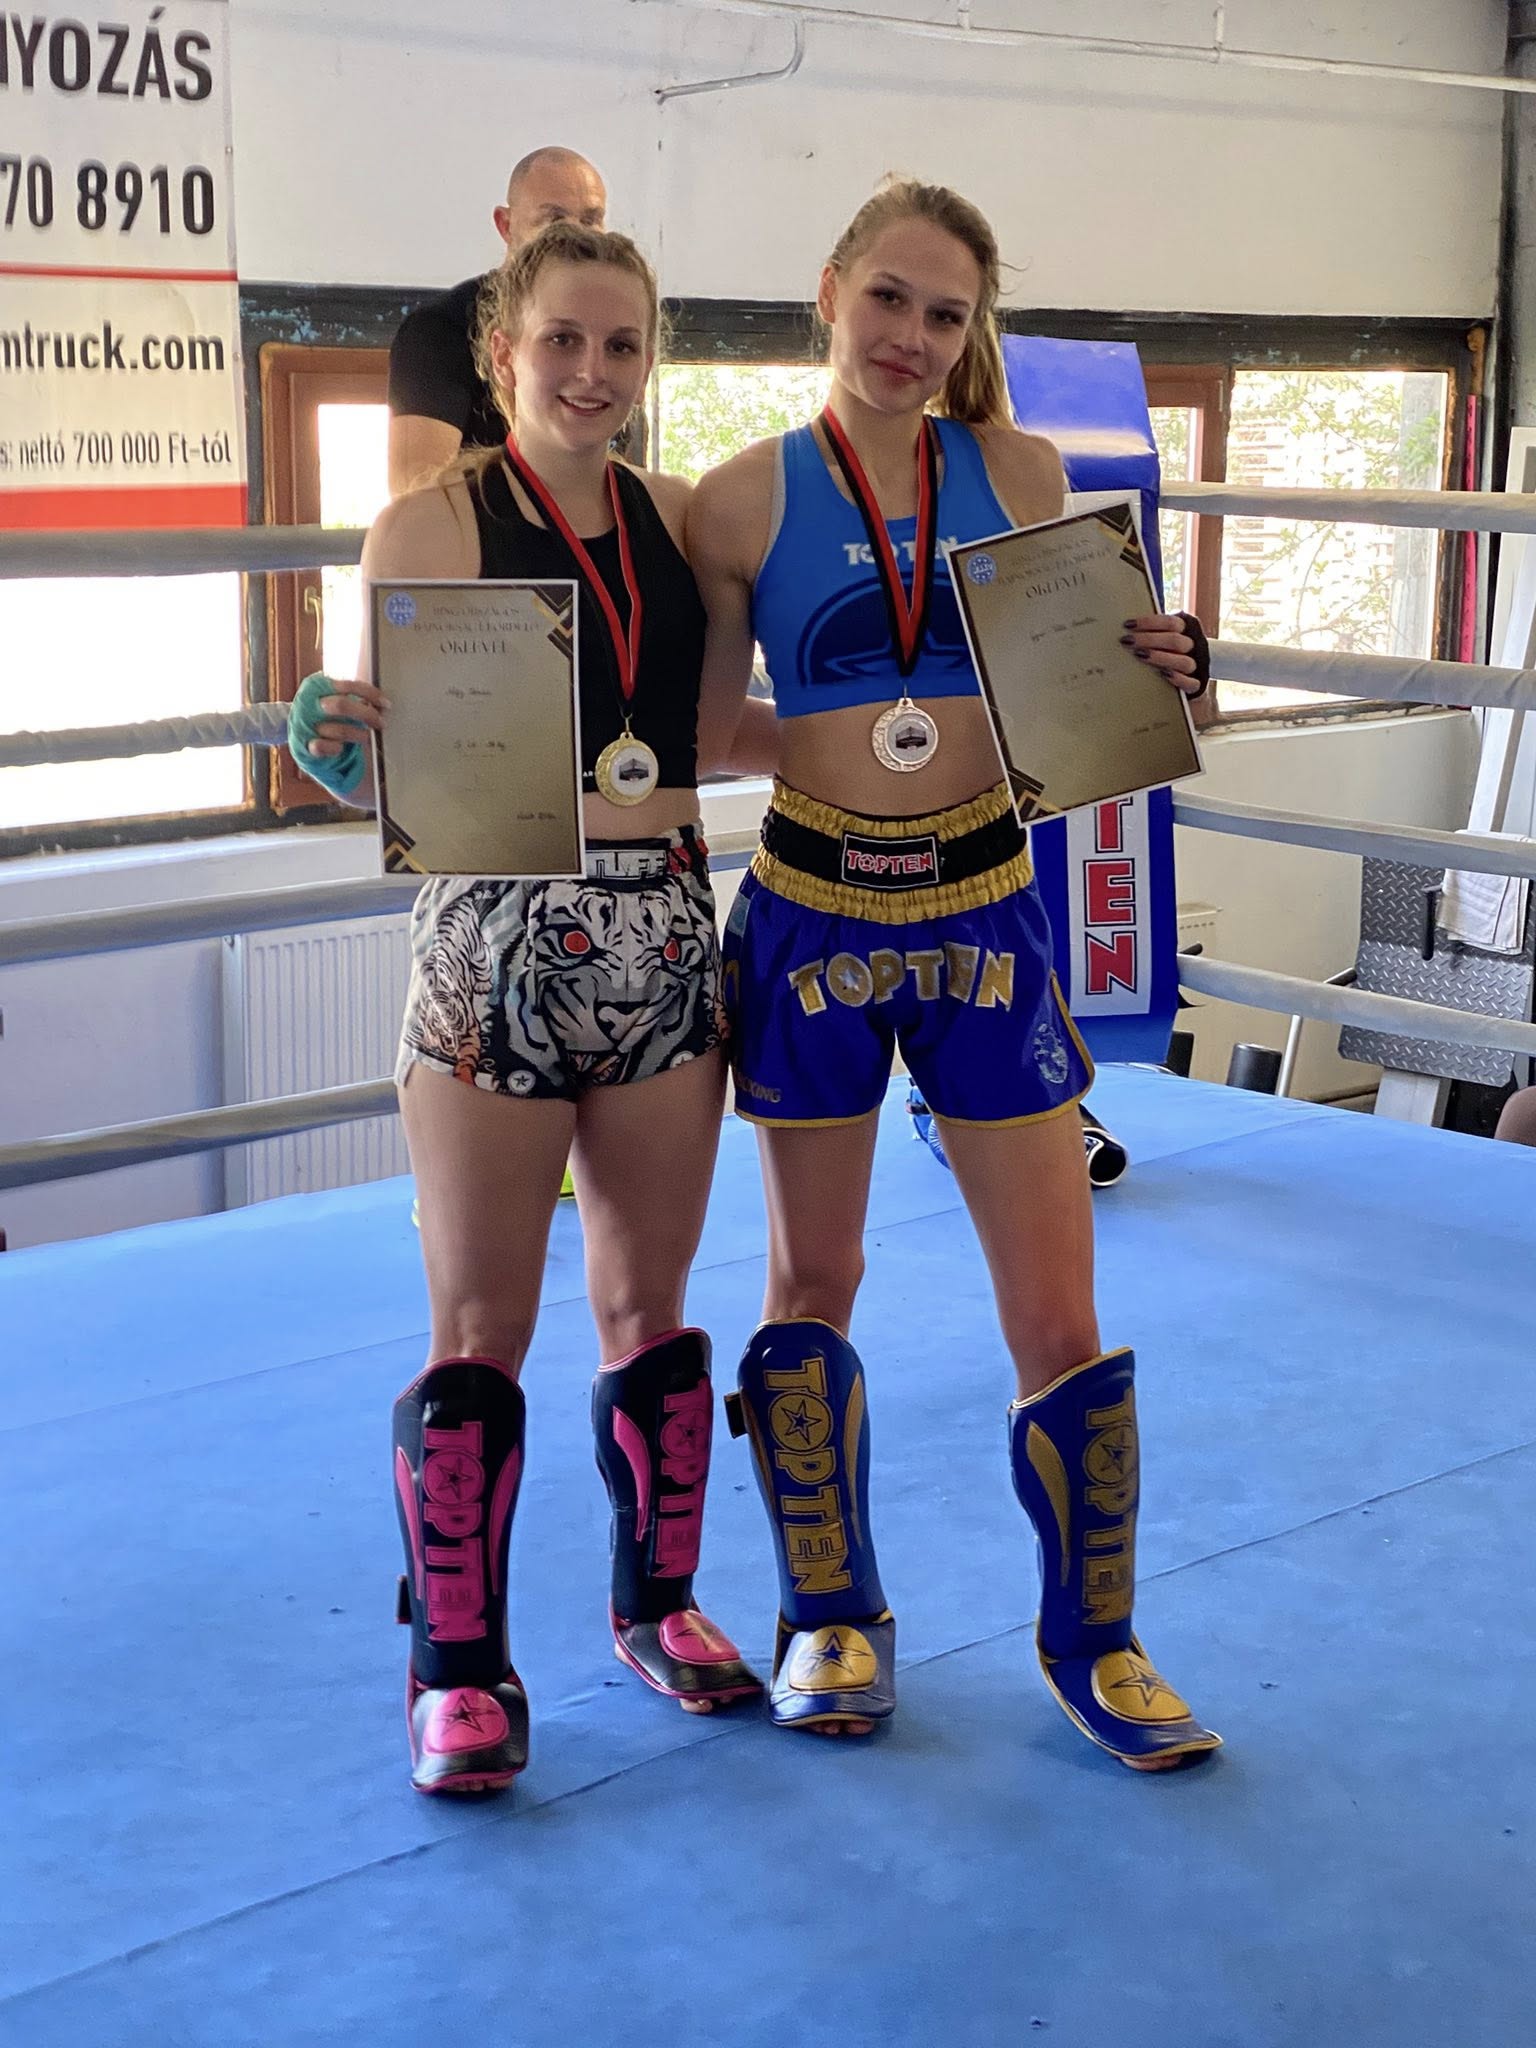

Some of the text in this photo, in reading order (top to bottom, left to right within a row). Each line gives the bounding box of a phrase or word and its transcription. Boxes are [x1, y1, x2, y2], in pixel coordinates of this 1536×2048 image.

[0, 153, 215, 236] 70 8910
[19, 429, 65, 470] nettó
[73, 431, 113, 466] 700
[121, 431, 160, 466] 000
[168, 429, 232, 466] Ft-tól
[847, 849, 933, 875] TOPTEN
[763, 1357, 852, 1594] TOPTEN
